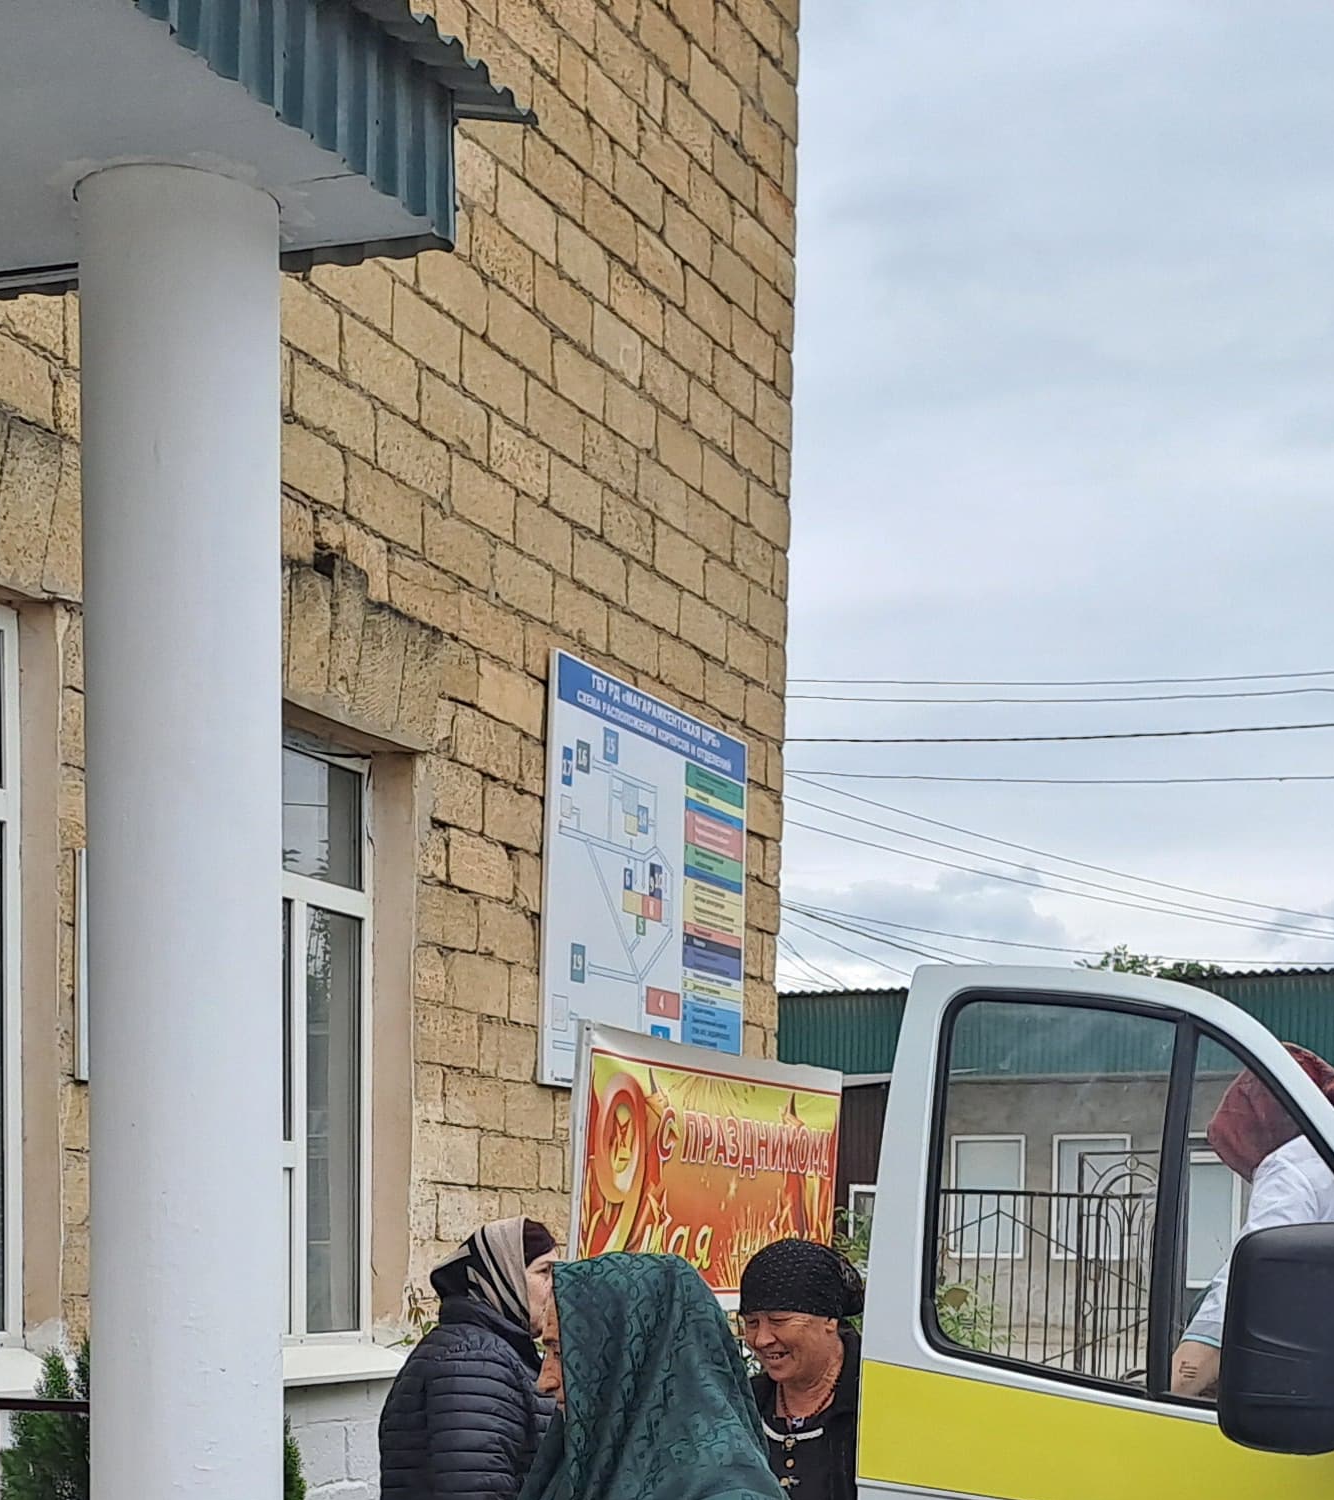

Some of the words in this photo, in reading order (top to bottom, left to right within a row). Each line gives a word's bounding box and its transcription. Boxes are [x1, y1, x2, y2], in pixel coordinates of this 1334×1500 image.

[608, 682, 621, 704] РД
[562, 758, 572, 776] 17
[577, 747, 588, 767] 16
[572, 953, 583, 971] 19
[657, 1106, 676, 1162] С
